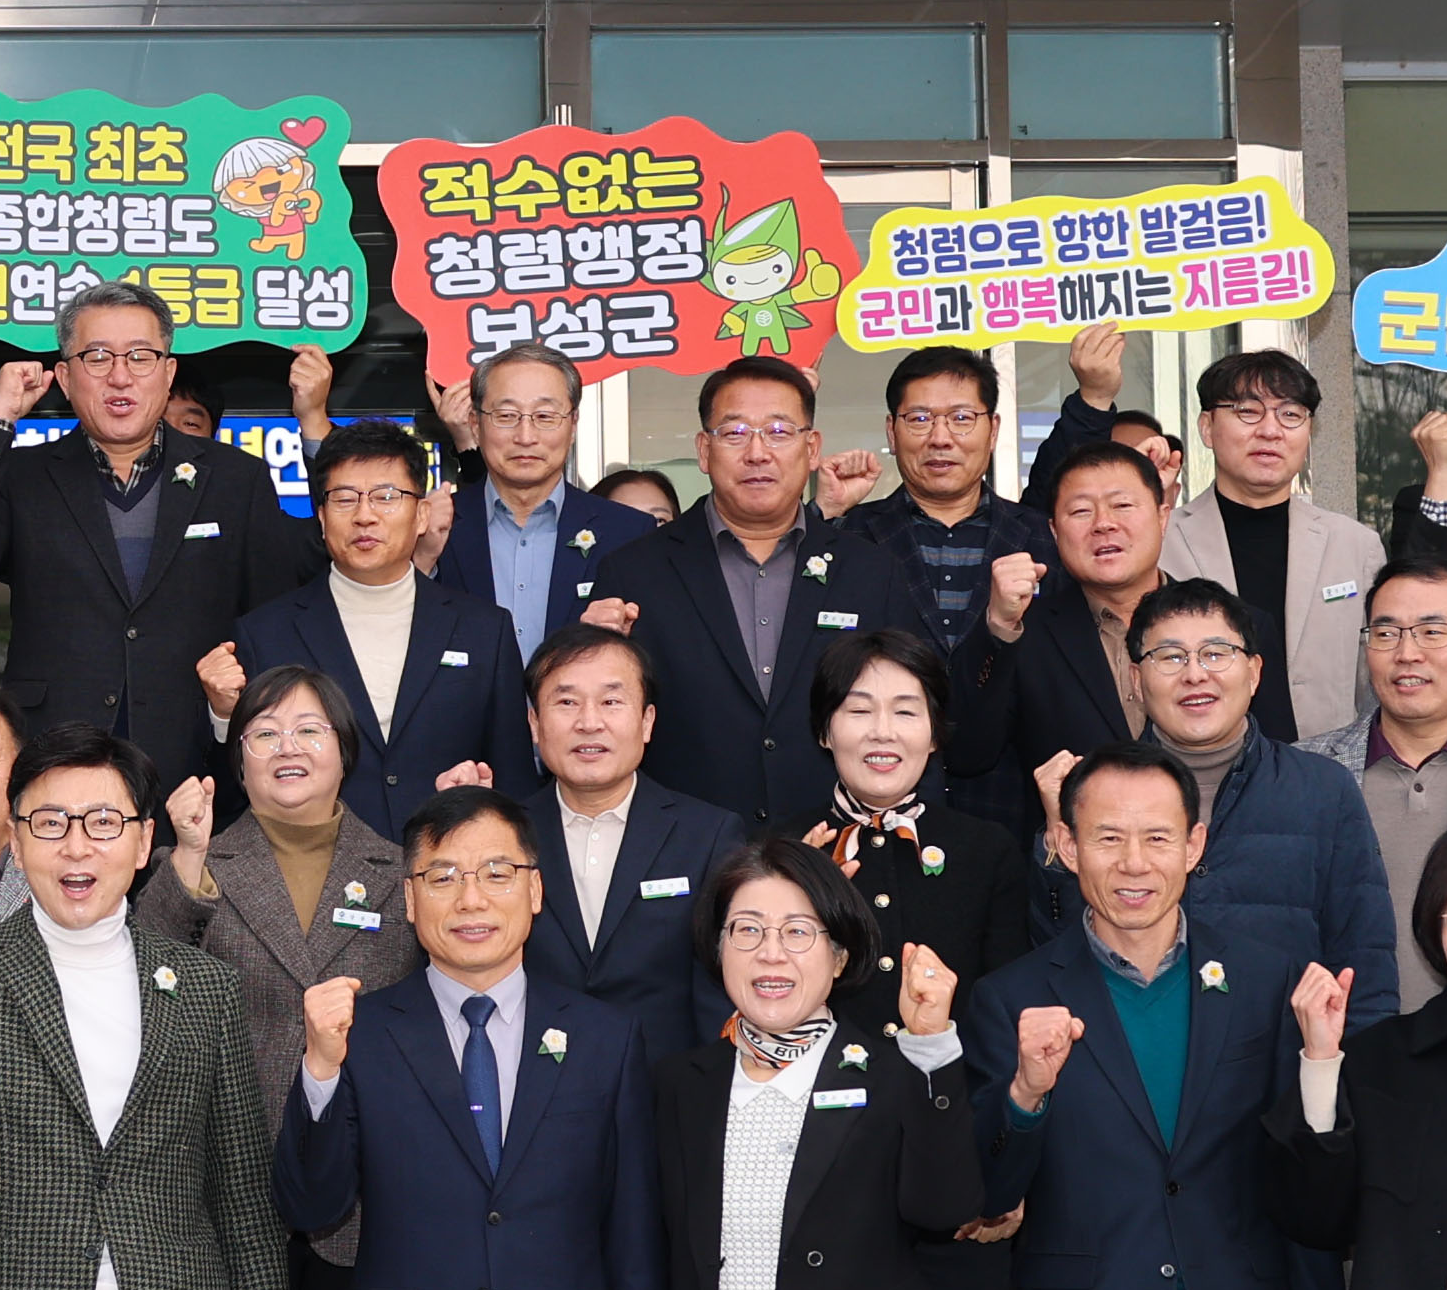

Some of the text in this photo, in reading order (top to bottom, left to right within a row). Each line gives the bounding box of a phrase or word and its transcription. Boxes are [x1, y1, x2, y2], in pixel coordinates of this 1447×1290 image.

[86, 121, 187, 186] 최초
[419, 147, 704, 223] 적수없는
[425, 216, 707, 299] 청렴행정
[894, 195, 1267, 276] 청렴으로 향한 발걸음!
[253, 264, 354, 330] 달성
[467, 290, 678, 367] 보성군
[859, 250, 1312, 338] 군민과 행복해지는 지름길!
